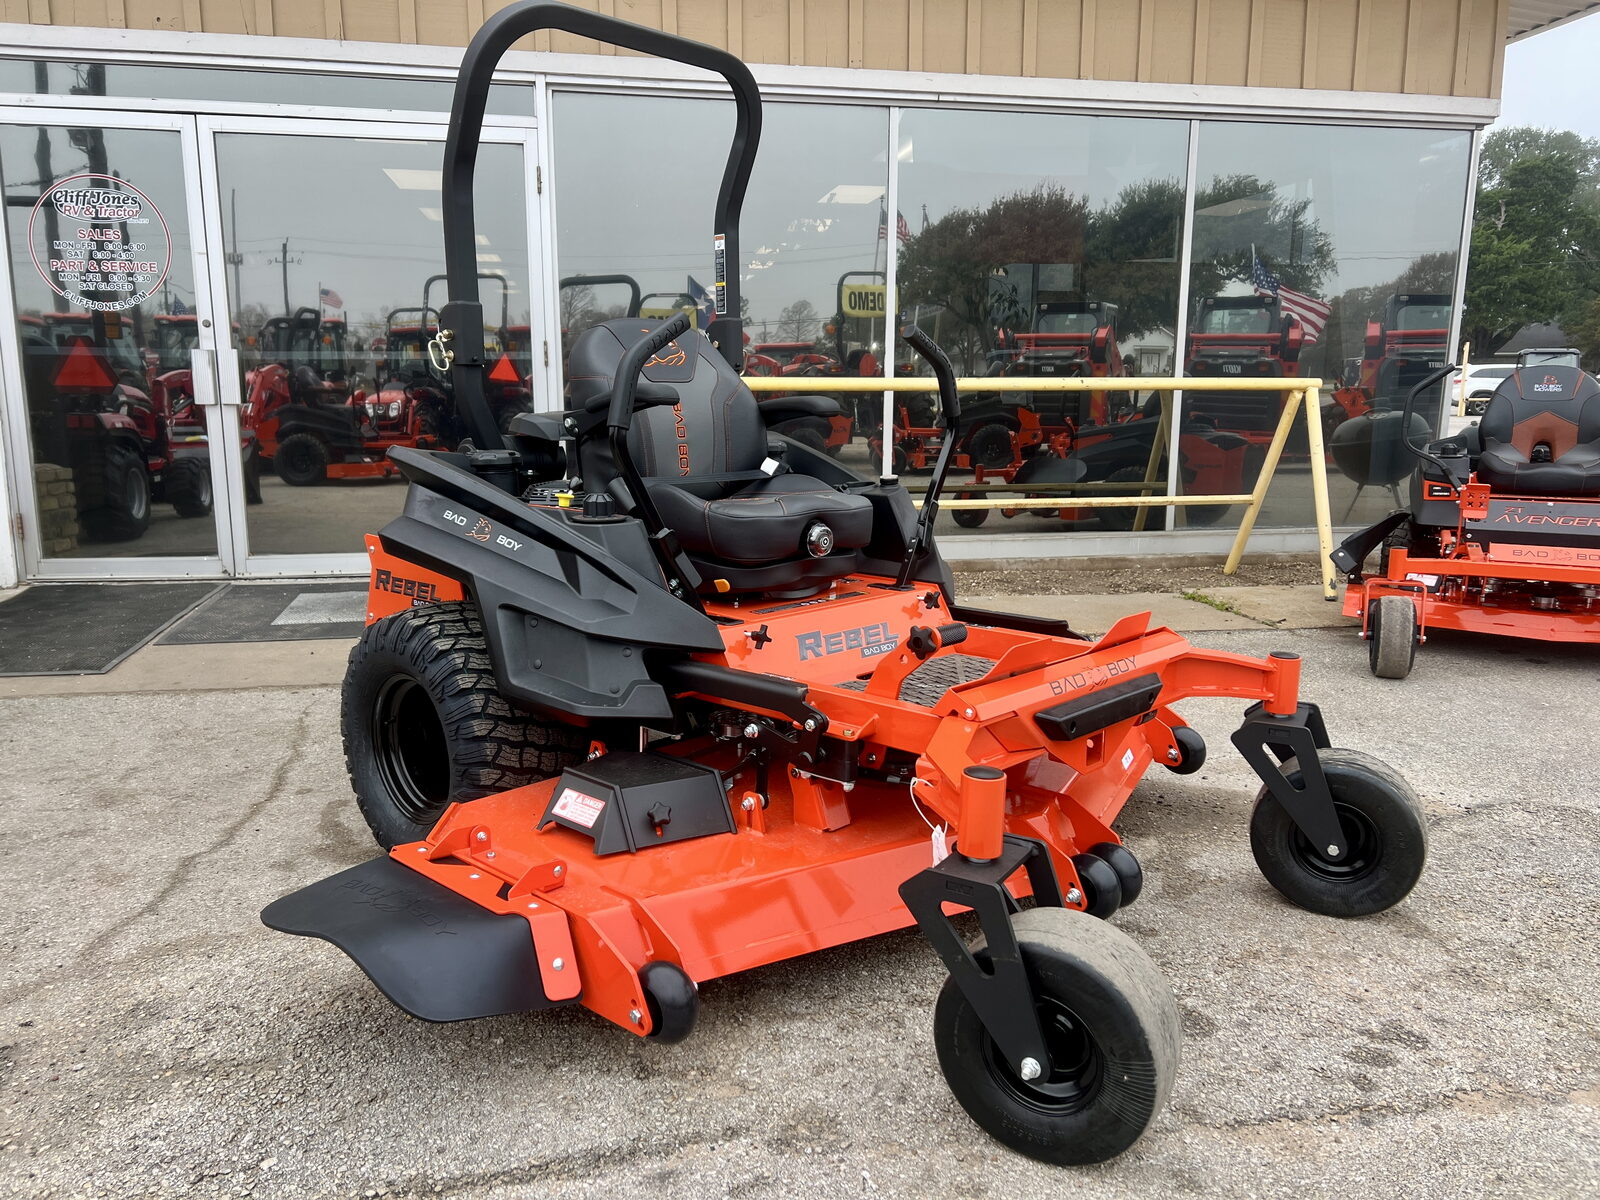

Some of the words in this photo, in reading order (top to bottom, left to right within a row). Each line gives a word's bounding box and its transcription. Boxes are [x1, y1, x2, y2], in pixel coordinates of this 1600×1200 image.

[53, 189, 89, 206] Cliff
[91, 190, 138, 205] Jones
[63, 205, 80, 216] RV
[84, 206, 93, 216] &
[97, 205, 140, 217] Tractor
[79, 229, 120, 240] SALES
[54, 241, 74, 249] MON
[81, 242, 96, 250] FRI
[104, 242, 121, 250] 8:00
[129, 243, 146, 251] 6:00
[93, 251, 111, 259] 8:00
[50, 260, 84, 271] PART
[88, 261, 98, 271] &
[102, 261, 158, 273] SERVICE
[59, 273, 79, 281] MON
[134, 274, 151, 282] 5:30
[80, 282, 96, 290] SAT
[97, 283, 133, 291] CLOSED
[62, 290, 148, 311] CLIFFJONES.COM
[443, 510, 467, 526] BAD
[496, 534, 523, 551] BOY
[1512, 549, 1548, 558] BAD
[375, 568, 441, 602] REBEL
[795, 622, 899, 661] REBEL
[863, 647, 880, 656] BAD
[881, 642, 896, 652] BOY
[1049, 673, 1087, 696] BAD
[1106, 655, 1137, 676] BOY
